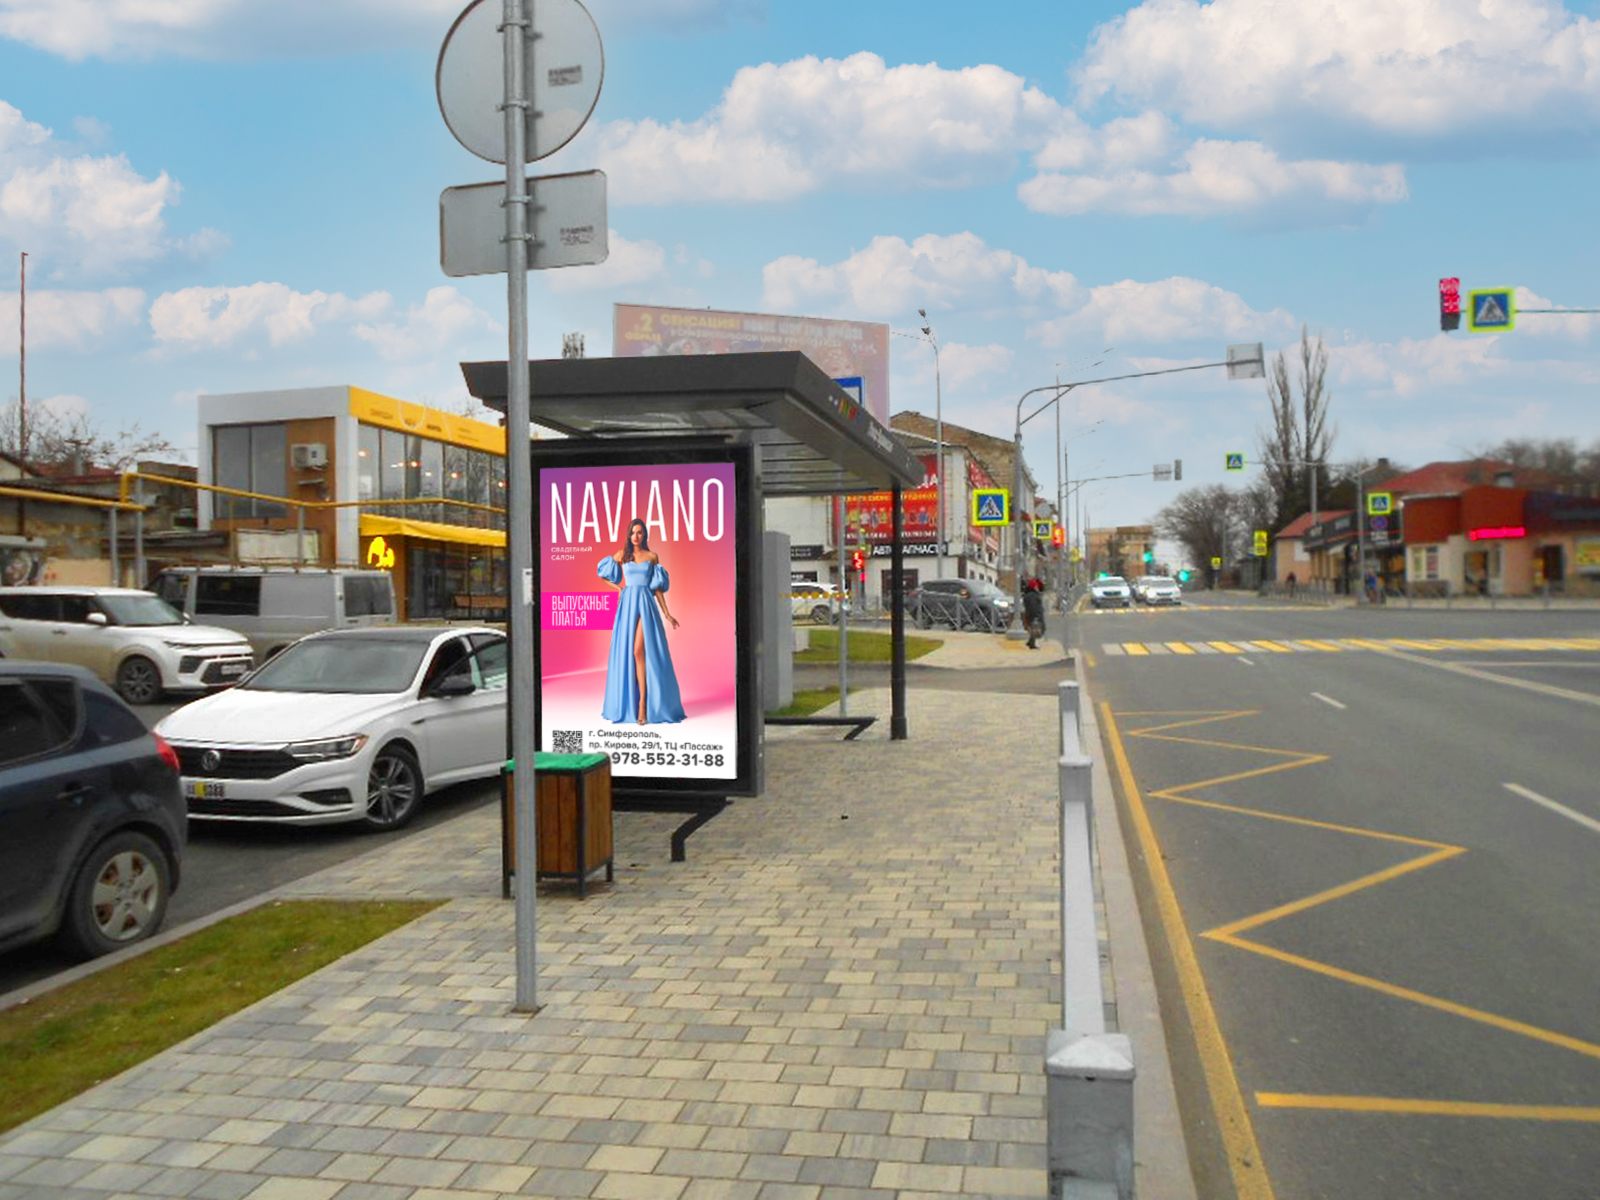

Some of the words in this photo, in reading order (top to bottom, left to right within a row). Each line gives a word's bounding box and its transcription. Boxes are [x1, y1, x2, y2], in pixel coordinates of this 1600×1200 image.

[551, 478, 724, 543] NAVIANO
[551, 595, 610, 611] ВЫПУСКНЫЕ
[552, 611, 587, 627] ПЛАТЬЯ
[597, 729, 662, 739] Симферополь,
[589, 742, 602, 750] пр.
[604, 741, 640, 750] Кирова,
[642, 741, 663, 751] 29/1,
[664, 742, 677, 751] ТЦ
[679, 743, 724, 752] «Пассаж»
